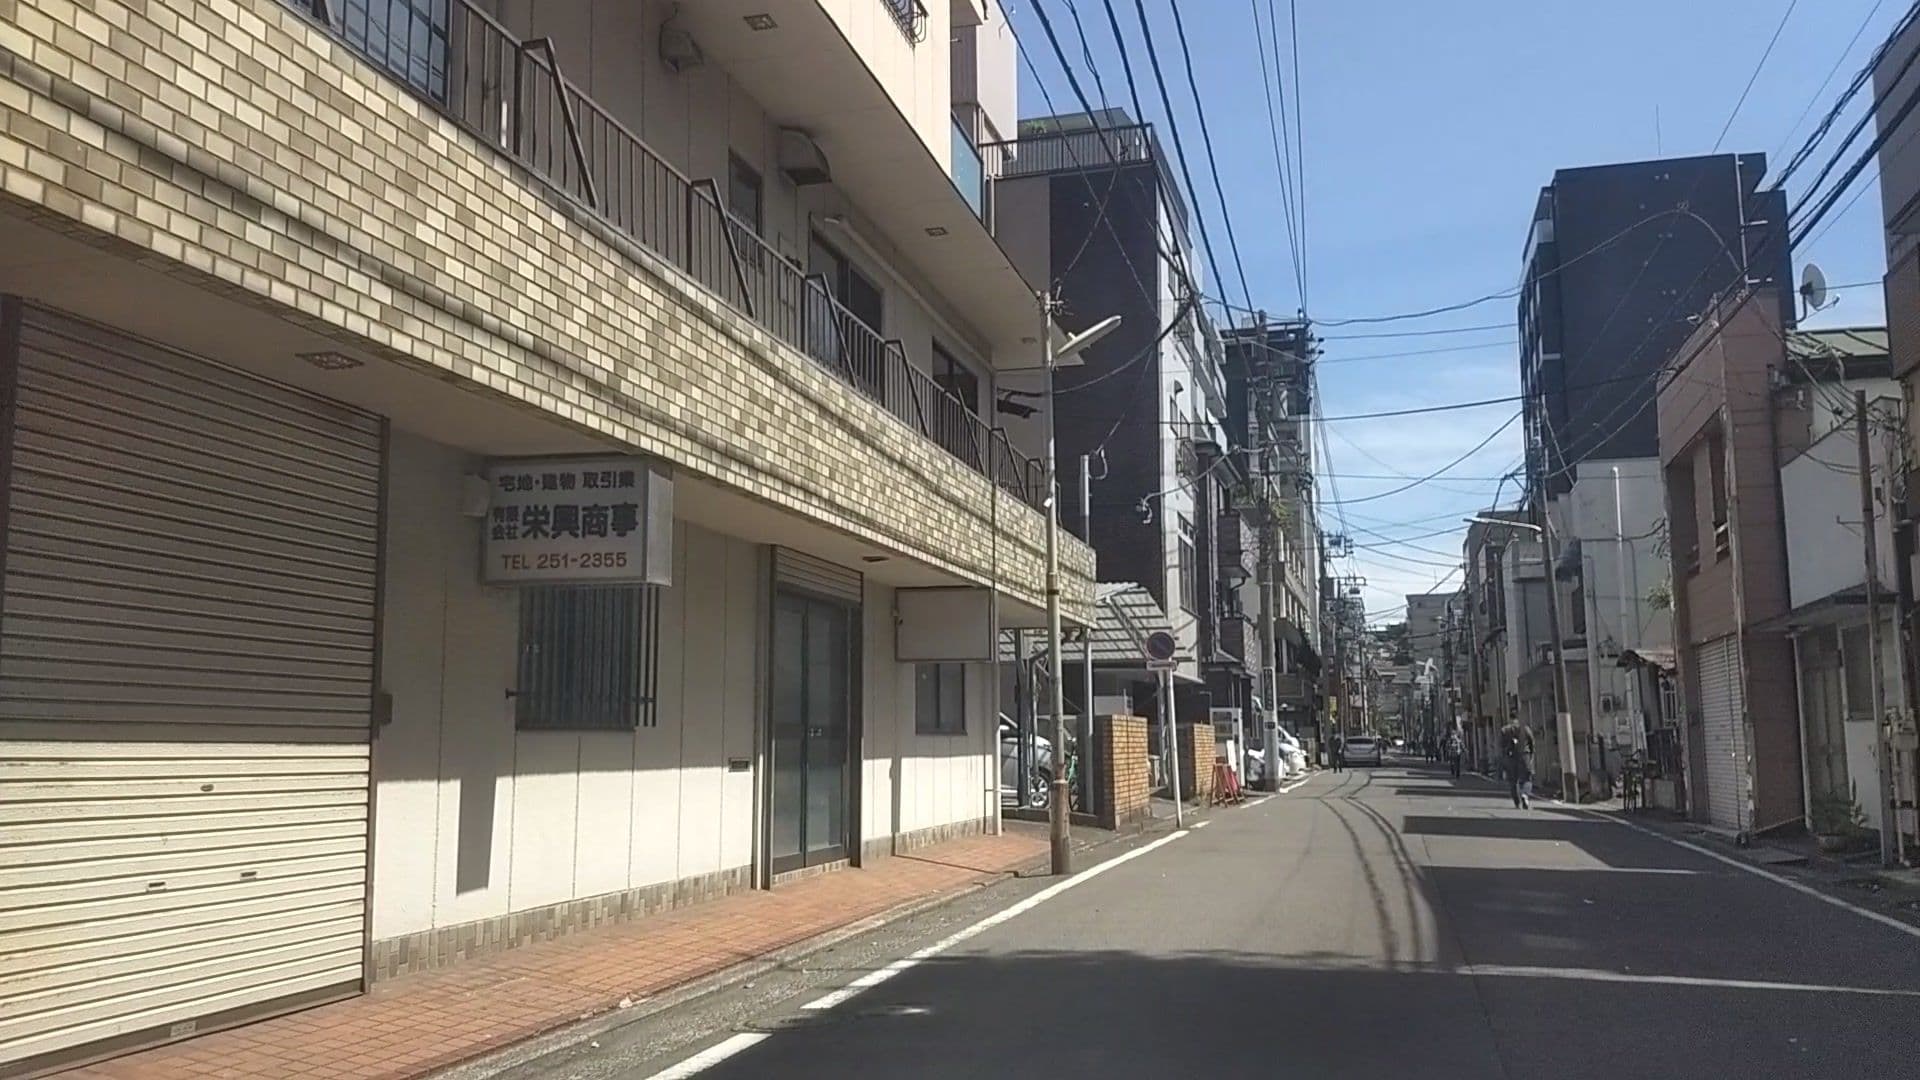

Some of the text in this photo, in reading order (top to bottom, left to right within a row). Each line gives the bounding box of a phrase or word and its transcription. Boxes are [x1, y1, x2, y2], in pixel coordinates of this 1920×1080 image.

[582, 471, 635, 489] 取引業
[522, 502, 639, 540] 栄興商事
[502, 551, 628, 570] TEL 251-2355
